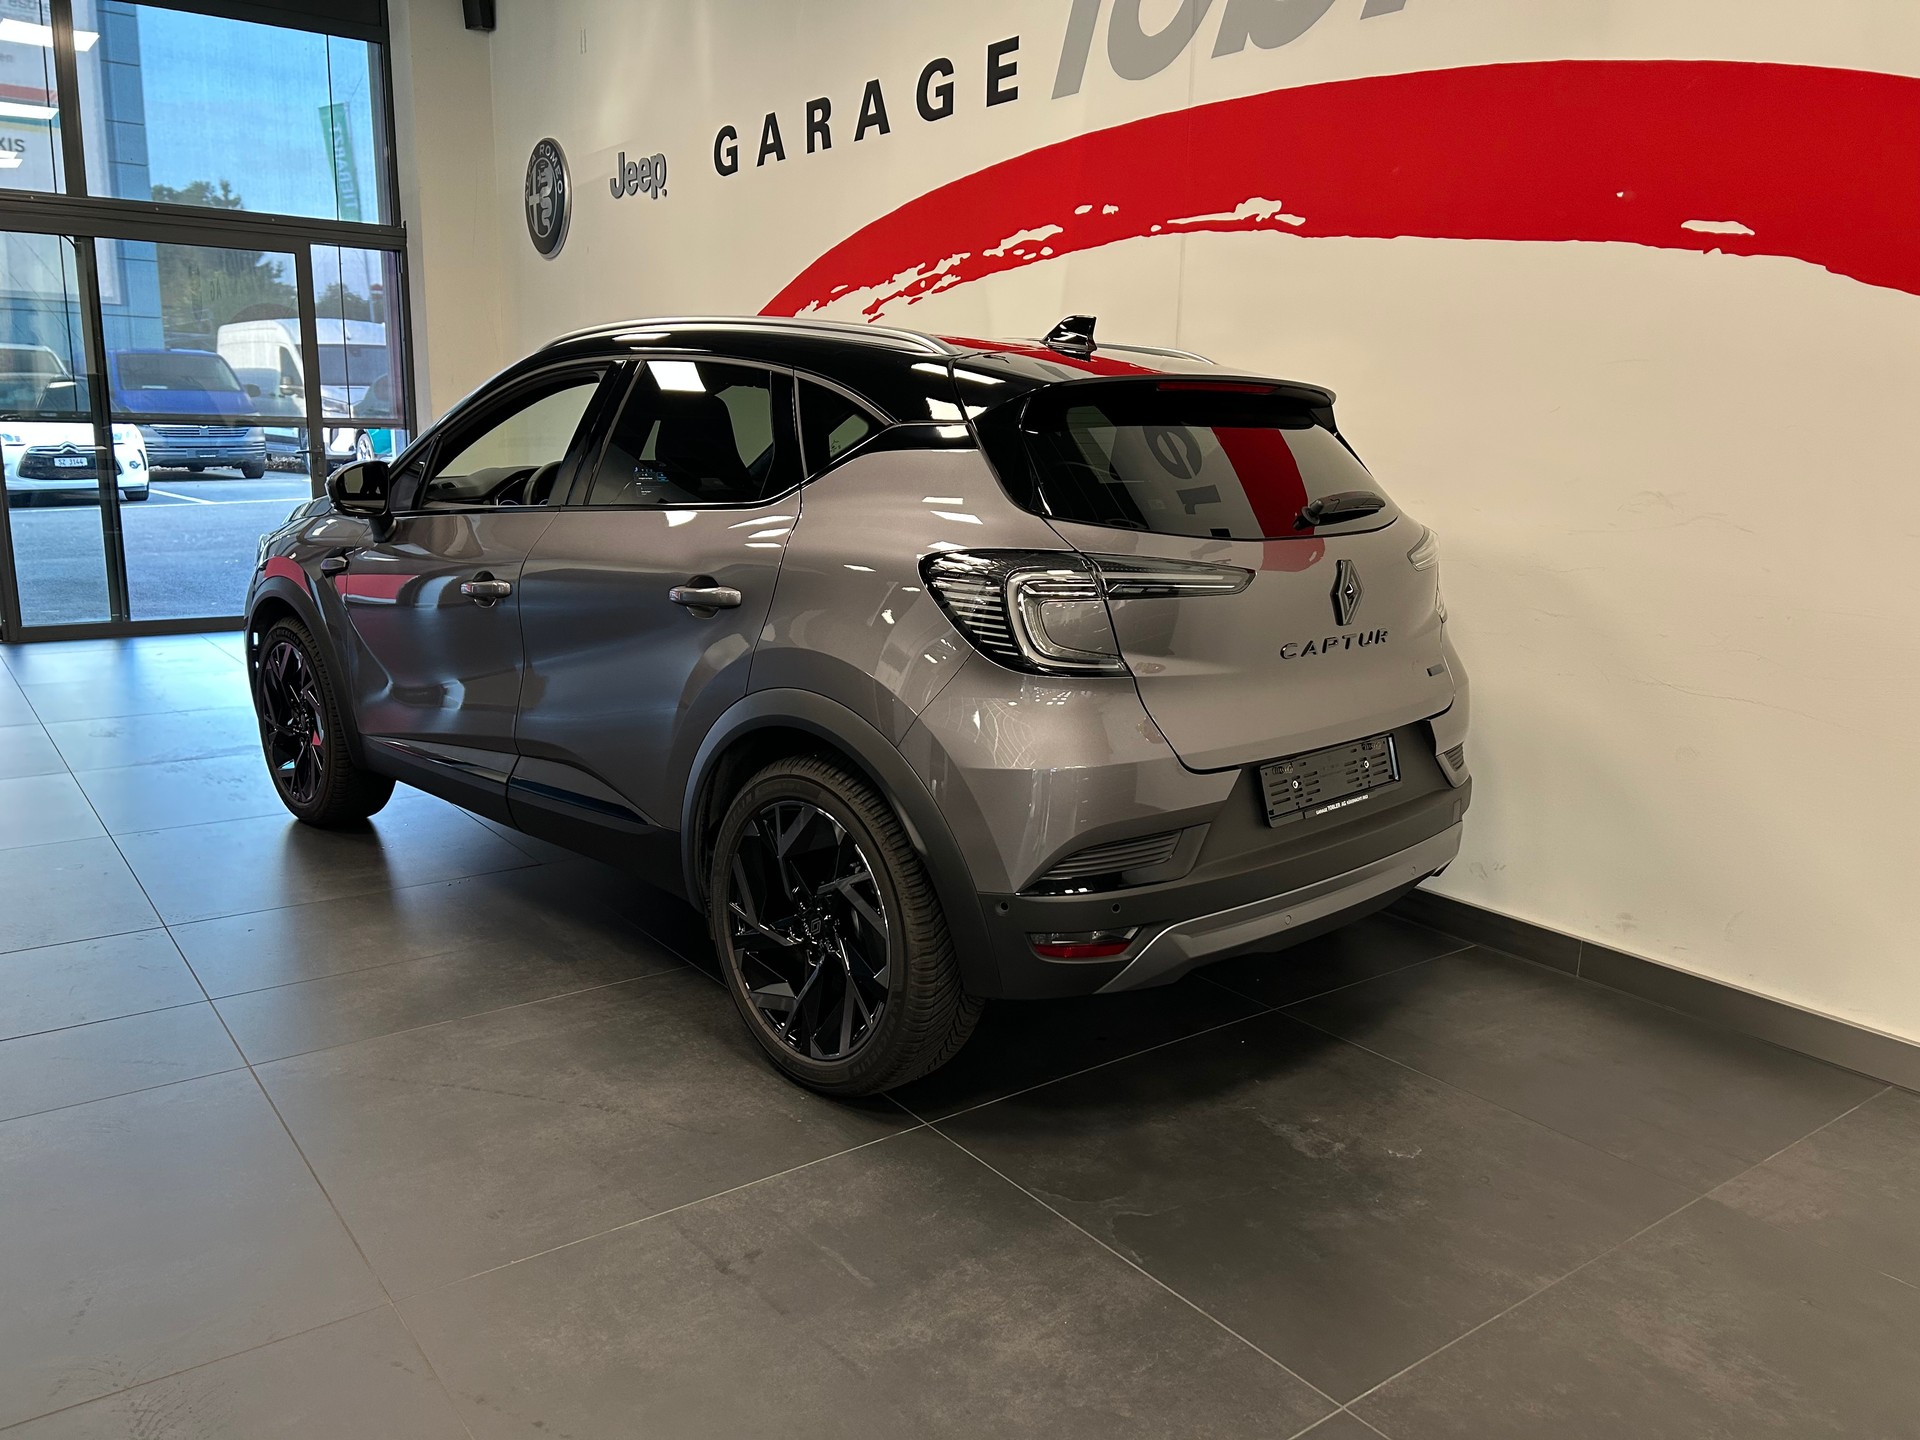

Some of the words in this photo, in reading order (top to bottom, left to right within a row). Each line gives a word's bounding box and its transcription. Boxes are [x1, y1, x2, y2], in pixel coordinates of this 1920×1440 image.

[713, 35, 1020, 177] GARAGE
[539, 143, 564, 195] ROMEO
[1279, 627, 1389, 660] CAPTUR
